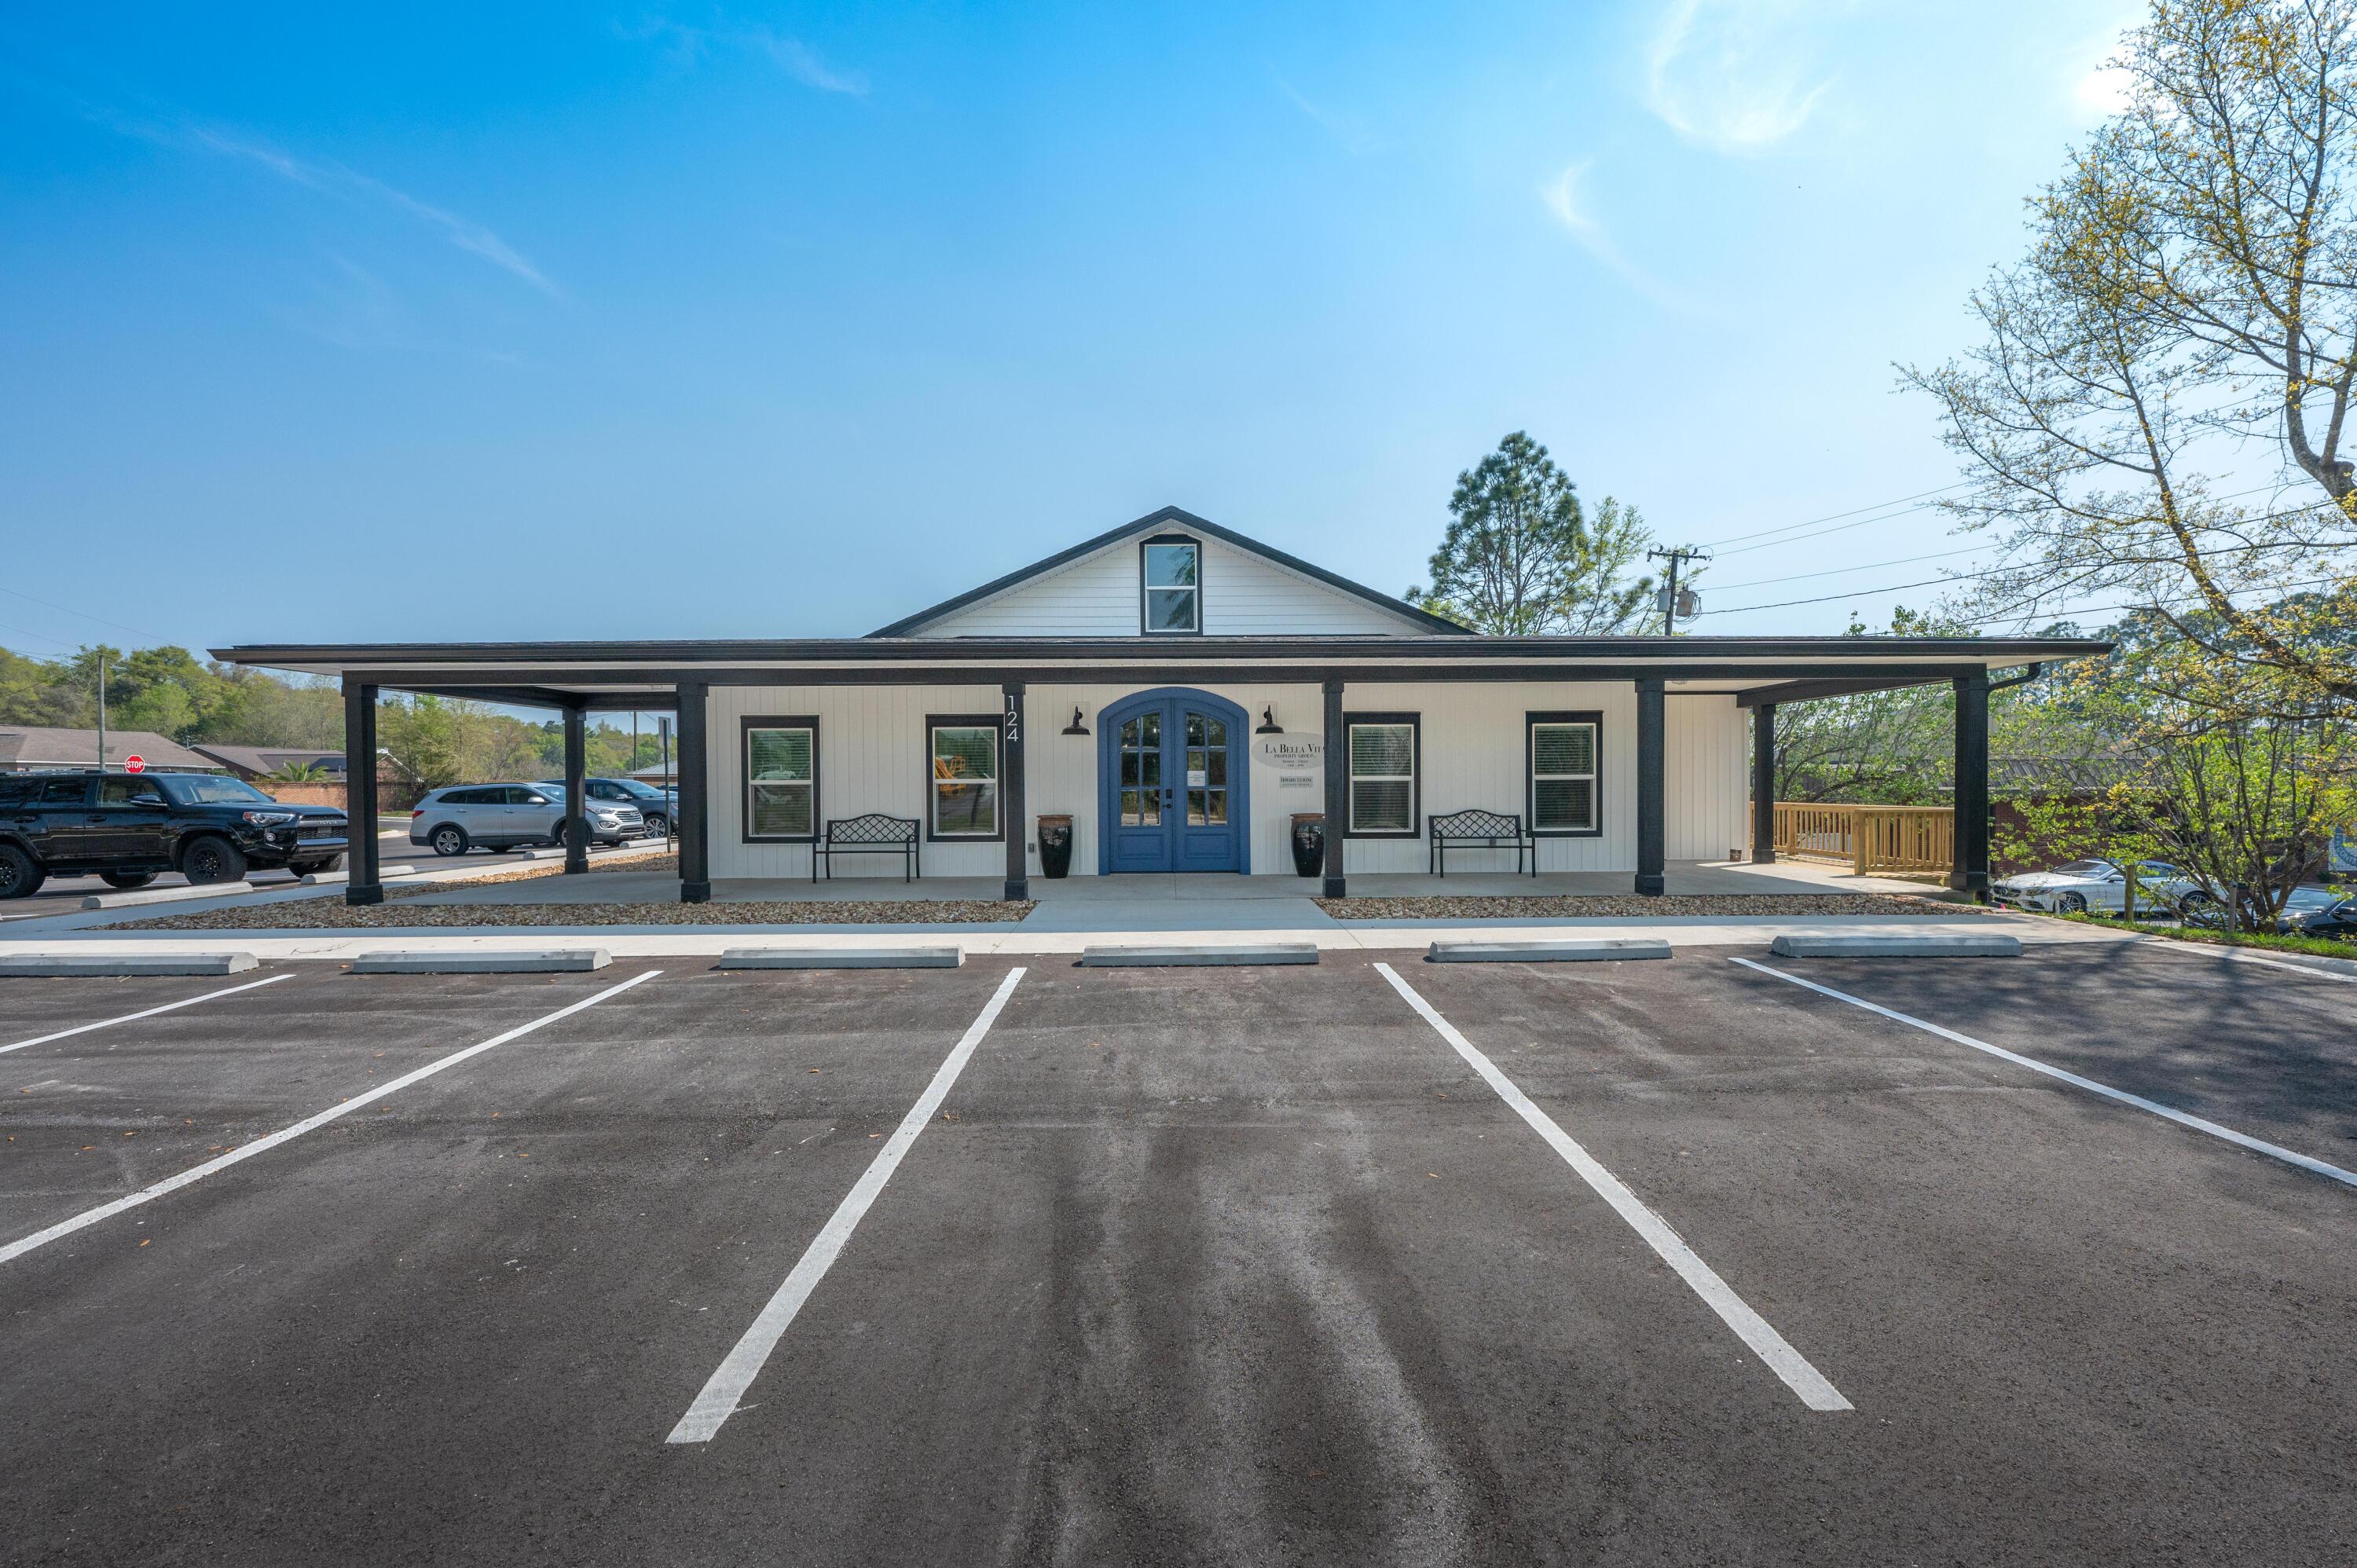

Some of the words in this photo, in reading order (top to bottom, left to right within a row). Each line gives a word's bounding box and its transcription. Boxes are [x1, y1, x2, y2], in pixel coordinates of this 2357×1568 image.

[1006, 695, 1018, 742] 124
[1266, 744, 1277, 753] LA
[1280, 744, 1305, 753] BELLA
